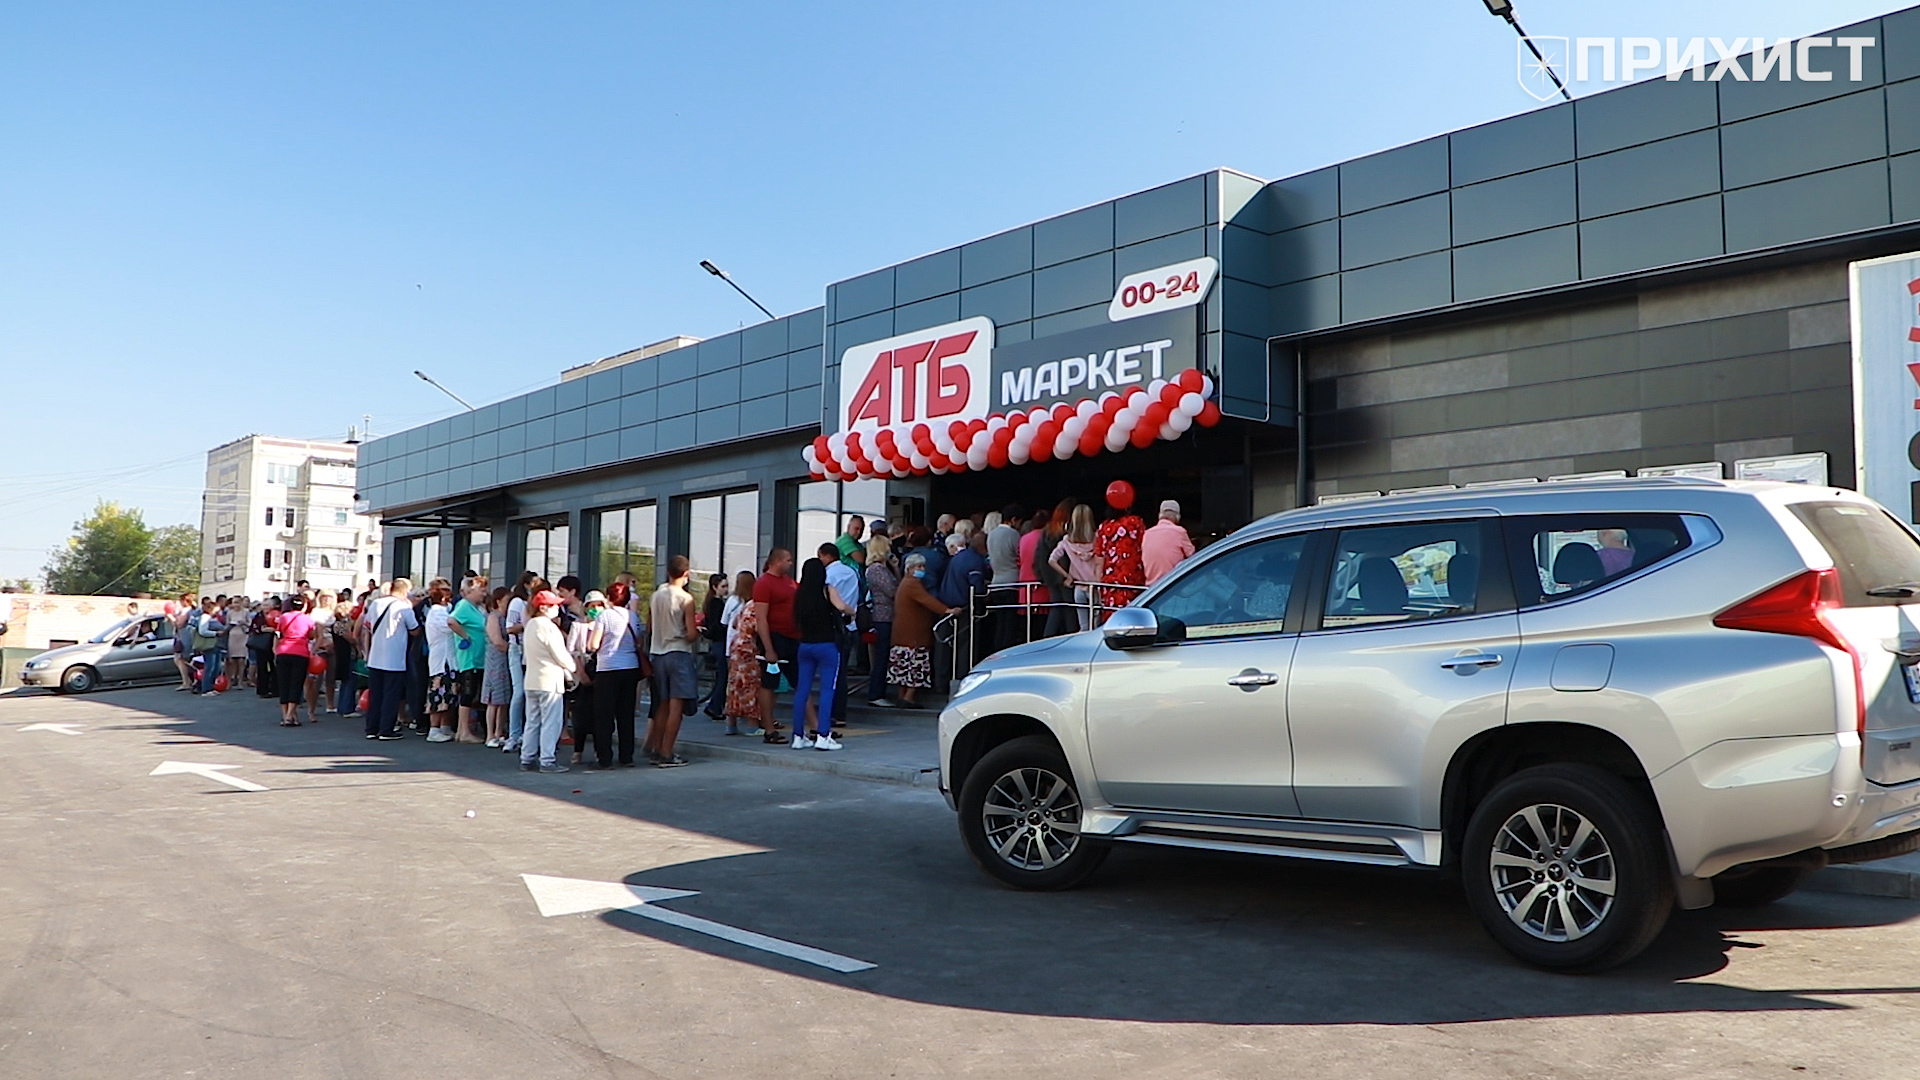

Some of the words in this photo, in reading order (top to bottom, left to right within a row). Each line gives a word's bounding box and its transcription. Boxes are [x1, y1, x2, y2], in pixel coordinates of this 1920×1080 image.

[1121, 271, 1200, 308] 00-24
[848, 330, 979, 431] АТБ
[1001, 339, 1173, 406] МАРКЕТ
